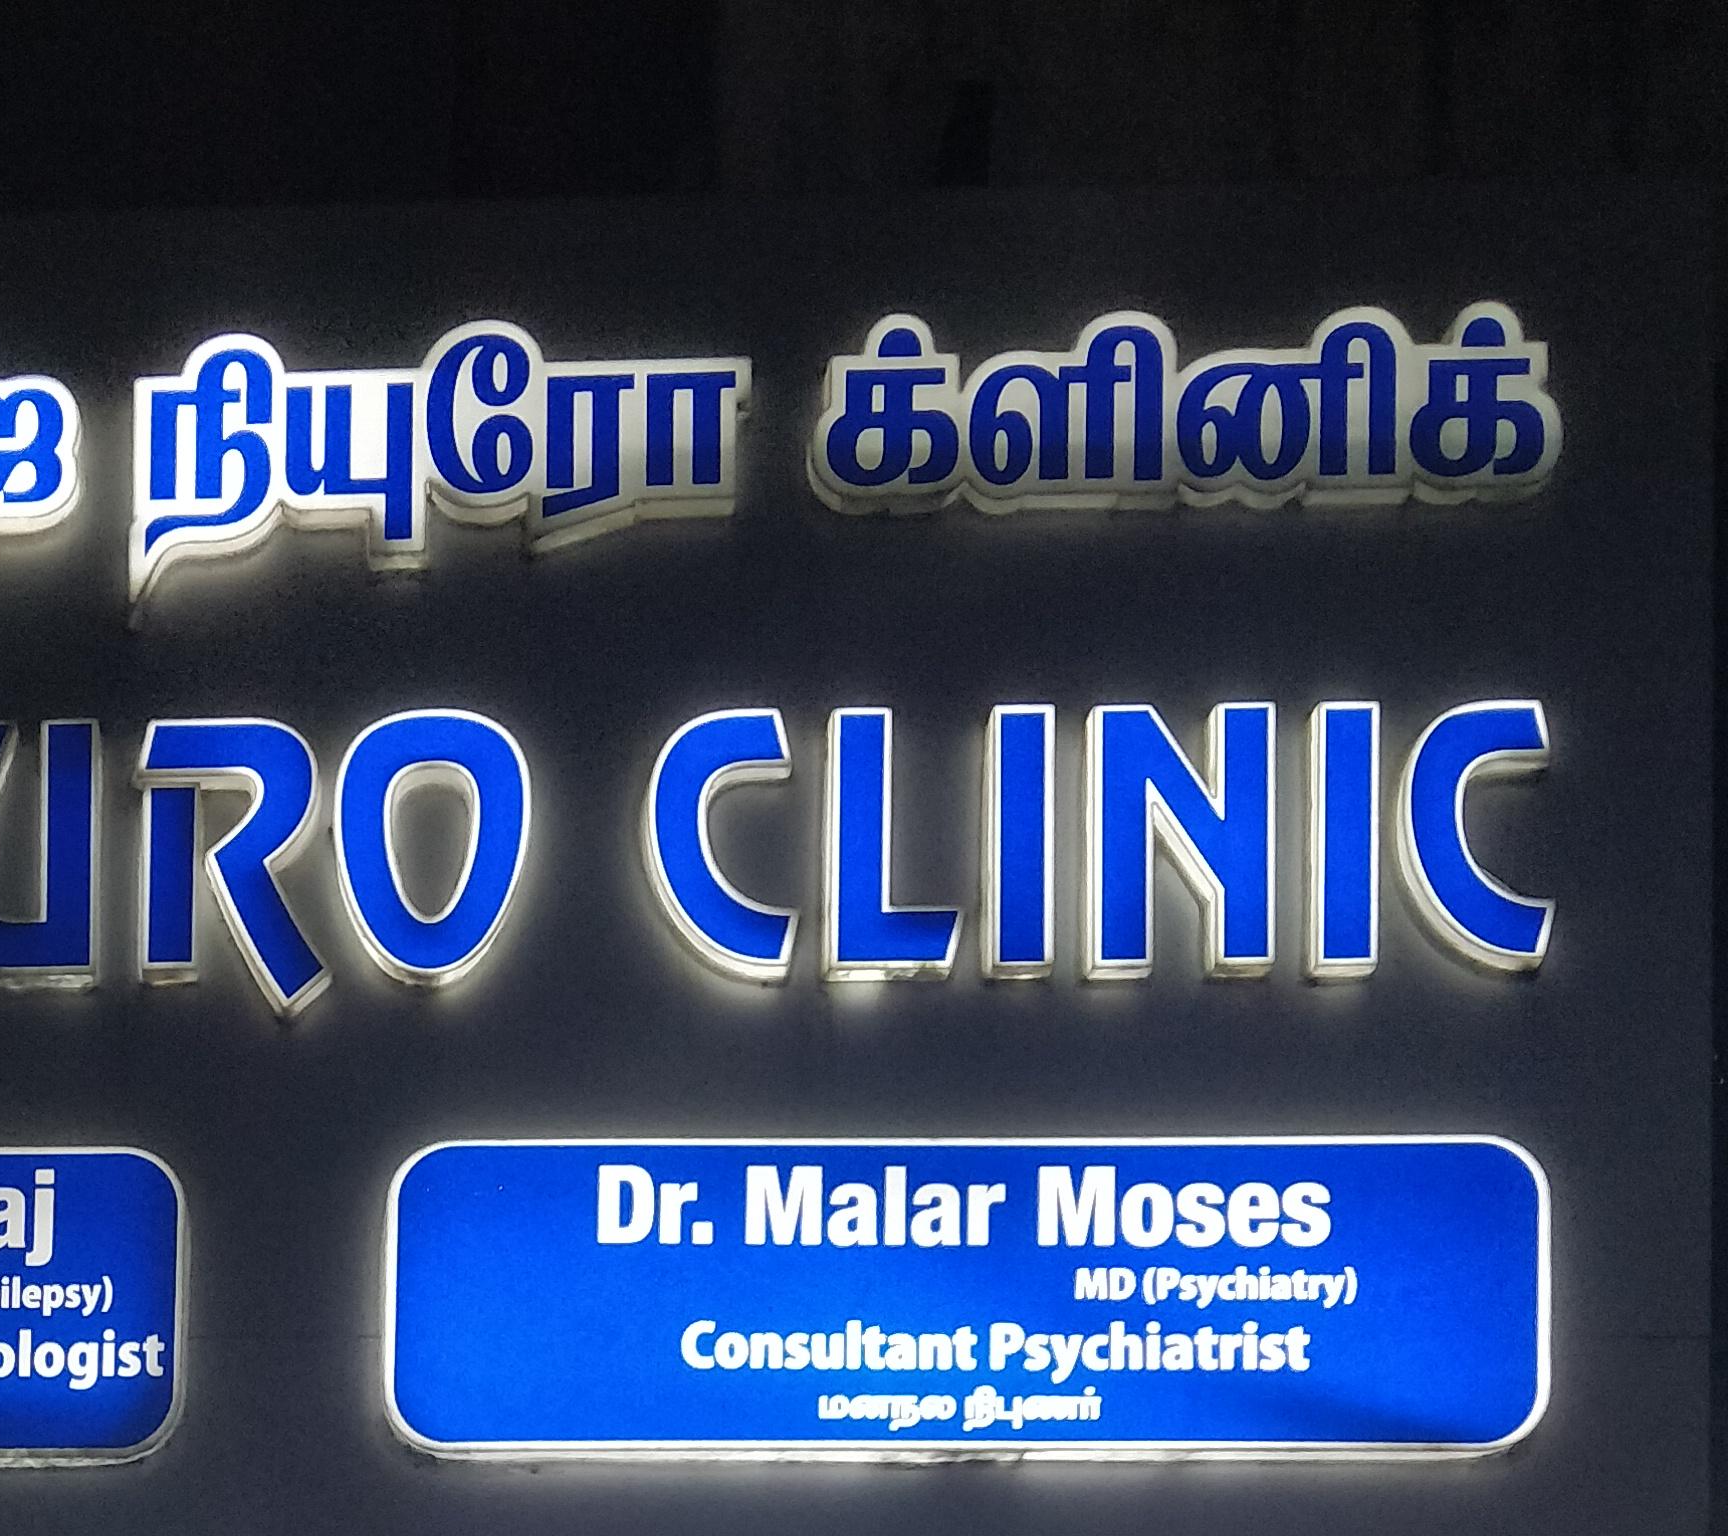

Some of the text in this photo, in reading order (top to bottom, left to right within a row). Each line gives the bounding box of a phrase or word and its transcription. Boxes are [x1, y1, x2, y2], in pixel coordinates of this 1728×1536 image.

[144, 332, 741, 552] நியுரோ
[823, 314, 1549, 489] க்ளினிக்
[644, 699, 1556, 980] CLINIC
[595, 1163, 1332, 1248] Dr. Malar Moses
[1074, 1265, 1359, 1309] MD (Psychiatry)
[680, 1318, 1312, 1384] Consultant Psychiatrist
